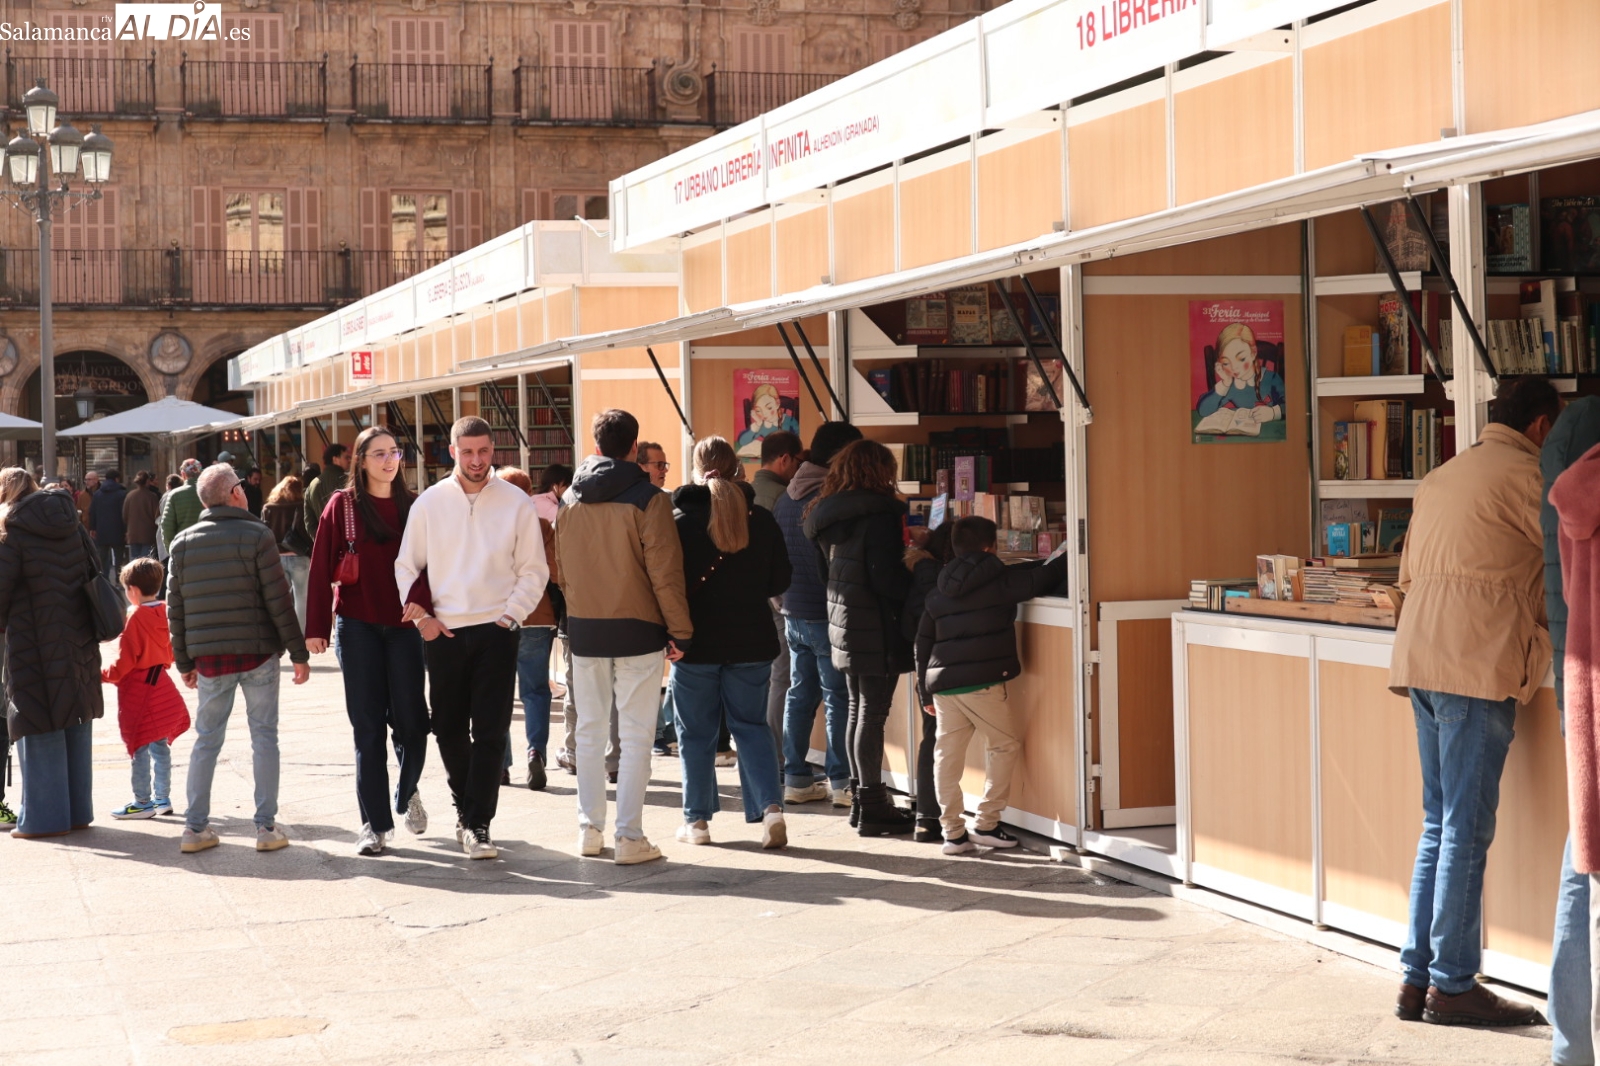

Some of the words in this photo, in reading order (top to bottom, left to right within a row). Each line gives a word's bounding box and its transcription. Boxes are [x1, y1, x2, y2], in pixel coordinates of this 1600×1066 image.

[1076, 11, 1096, 50] 18
[1101, 0, 1197, 41] LIBRE
[673, 181, 682, 205] 17
[684, 166, 719, 201] URBANO
[720, 143, 762, 189] LIBRERÍA
[768, 129, 811, 171] INFINITA
[843, 114, 880, 146] (GRANADA)
[1210, 304, 1241, 318] Feria
